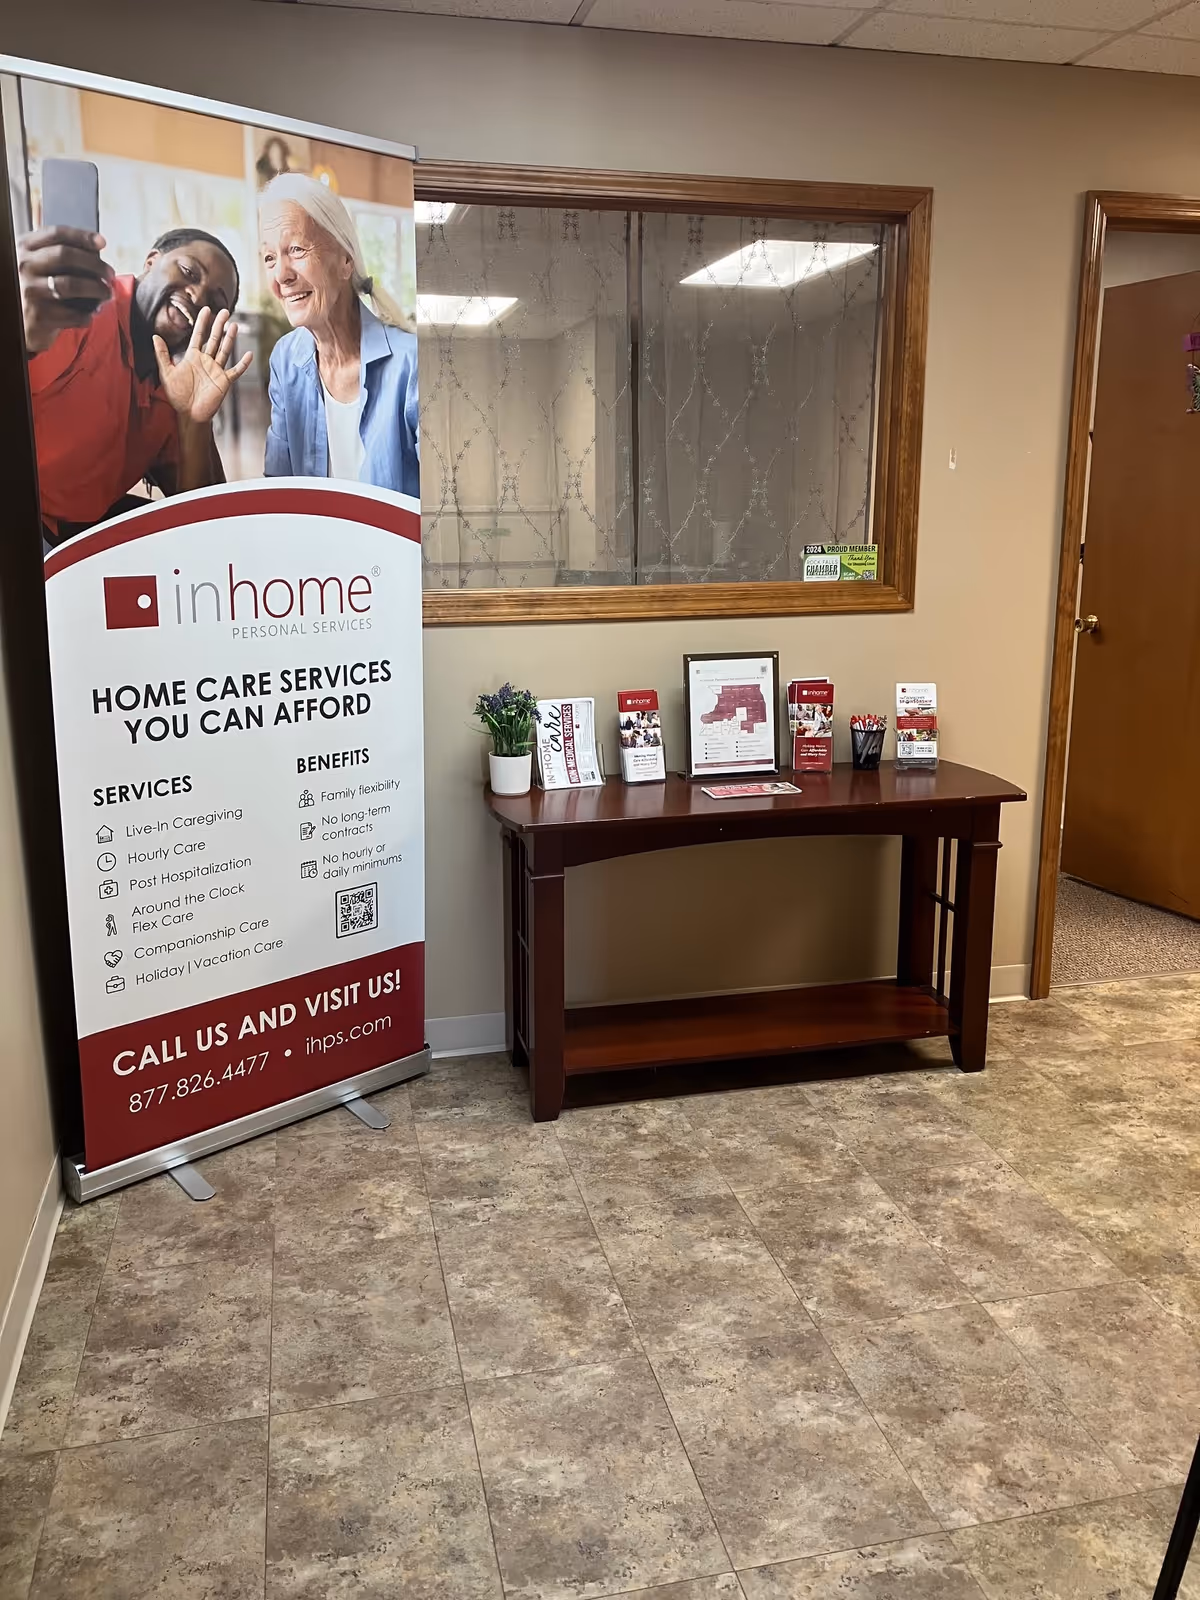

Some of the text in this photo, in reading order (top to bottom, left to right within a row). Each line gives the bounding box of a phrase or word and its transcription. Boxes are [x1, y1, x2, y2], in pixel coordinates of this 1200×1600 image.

[806, 545, 822, 553] 2024
[806, 564, 838, 574] CHAMBER
[232, 618, 372, 639] PERSONAL SERVICES
[92, 659, 392, 714] HOME CARE SERVICES
[124, 693, 371, 744] YOU CAN AFFORD
[544, 704, 562, 753] care
[562, 704, 580, 784] NON-MEDICAL SERVICES
[297, 748, 370, 774] BENEFITS
[542, 738, 556, 784] IN-HOME
[93, 775, 192, 806] SERVICES
[321, 778, 401, 802] Family flexibility
[126, 808, 243, 837] Live-In Caregiving
[322, 805, 391, 826] No long-term
[322, 823, 374, 841] contracts
[128, 841, 206, 864] Hourly Care
[322, 843, 386, 864] No hourly or
[323, 853, 402, 880] daily minimums
[129, 857, 252, 891] Post Hospitalization
[131, 883, 245, 917] Around the Clock
[132, 911, 194, 934] Flex Care
[134, 919, 270, 959] Companionship Care
[136, 964, 185, 985] Holiday
[193, 948, 251, 969] Vacation
[254, 938, 284, 953] Care
[112, 969, 401, 1076] CALL US AND VISIT US!
[129, 1014, 392, 1114] 877.826.4477 ihps.com
